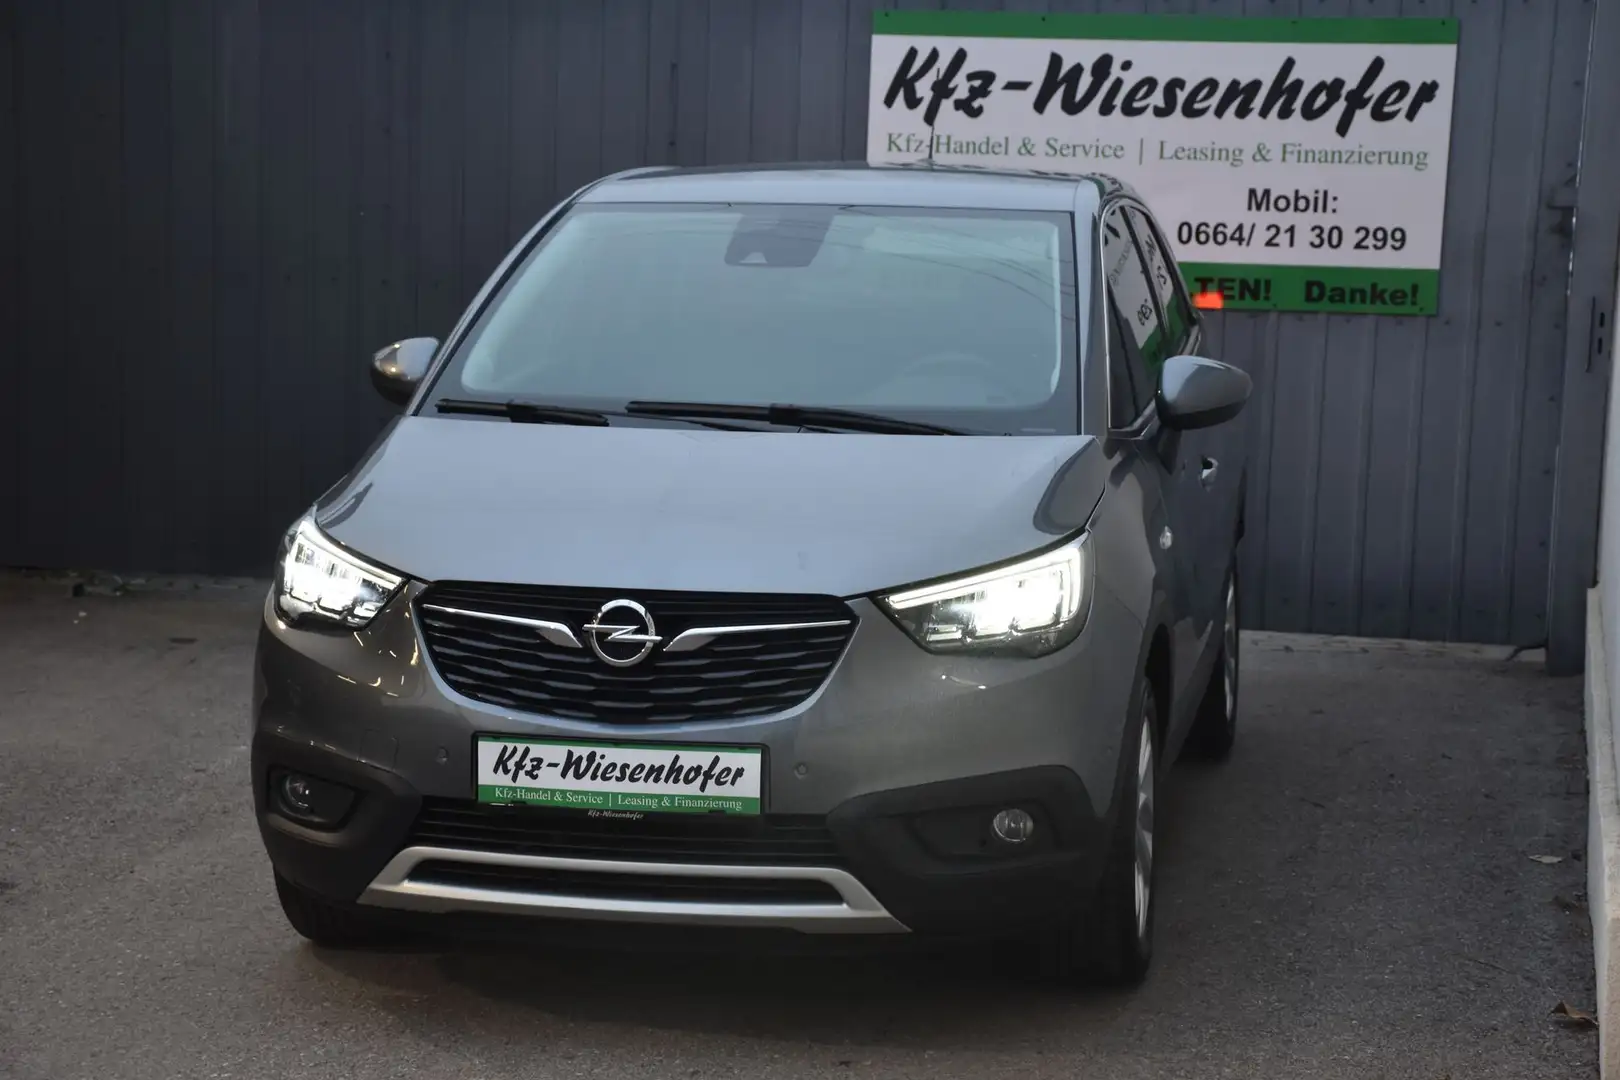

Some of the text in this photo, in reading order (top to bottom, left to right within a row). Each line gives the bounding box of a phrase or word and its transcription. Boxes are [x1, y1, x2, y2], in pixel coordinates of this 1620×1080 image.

[883, 46, 1439, 138] Kfz-Wiesenhofer
[887, 132, 1009, 157] Kfz-Handel
[1017, 137, 1034, 157] &
[1045, 137, 1125, 160] Service
[1158, 140, 1245, 168] Leasing
[1251, 143, 1272, 163] &
[1280, 143, 1429, 170] Finanzierung
[1247, 189, 1339, 214] Mobil:
[1177, 222, 1407, 251] 0664/ 21 30 299
[1190, 277, 1420, 306] TEN! Danke!
[492, 744, 744, 793] Kfz-Wiesenhofer
[495, 787, 551, 800] Kfz-Handel
[553, 790, 563, 802] &
[566, 791, 603, 804] Service
[618, 794, 658, 808] Leasing
[661, 797, 670, 808] &
[674, 797, 742, 811] Finanzierung
